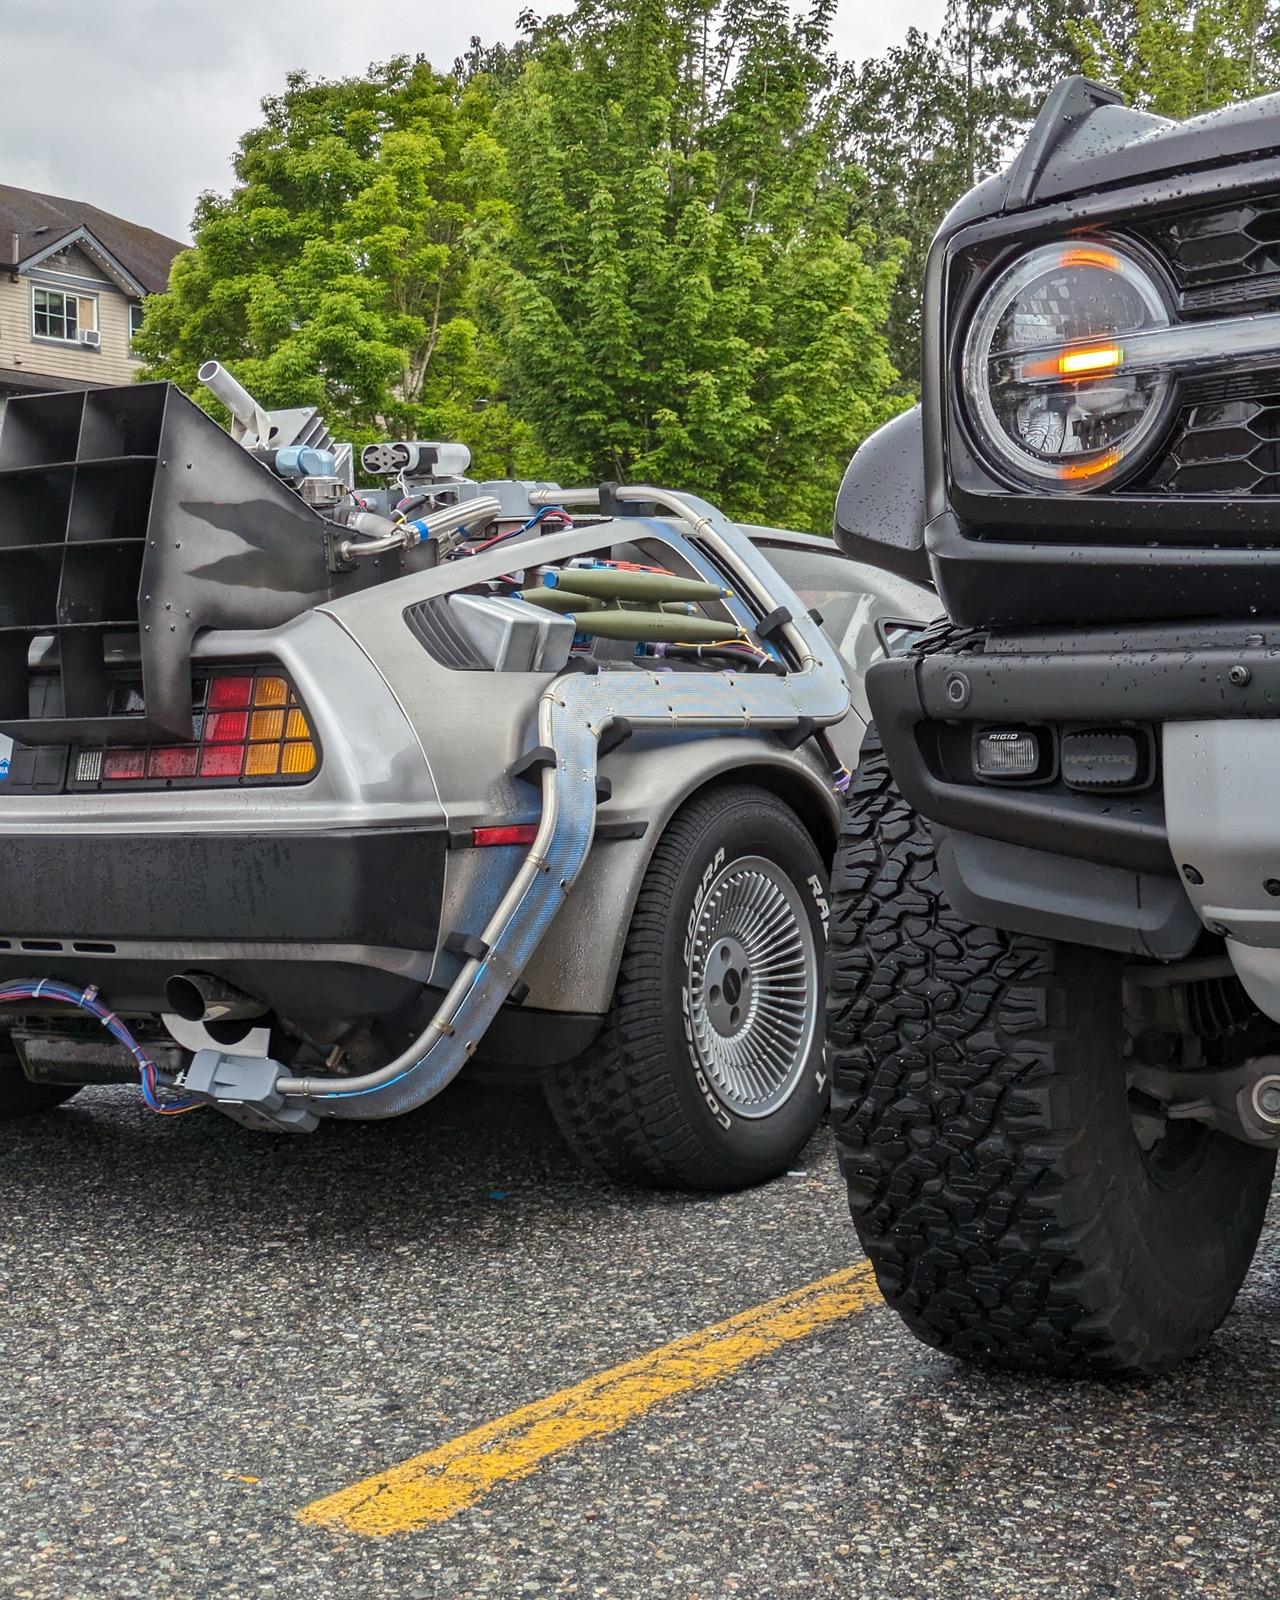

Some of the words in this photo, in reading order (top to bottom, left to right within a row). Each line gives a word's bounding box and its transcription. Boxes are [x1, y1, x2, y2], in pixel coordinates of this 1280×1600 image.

[989, 733, 1019, 741] RIGID
[1065, 754, 1132, 765] RAPTOR
[684, 847, 725, 967] COBRA
[682, 986, 731, 1130] COOPER
